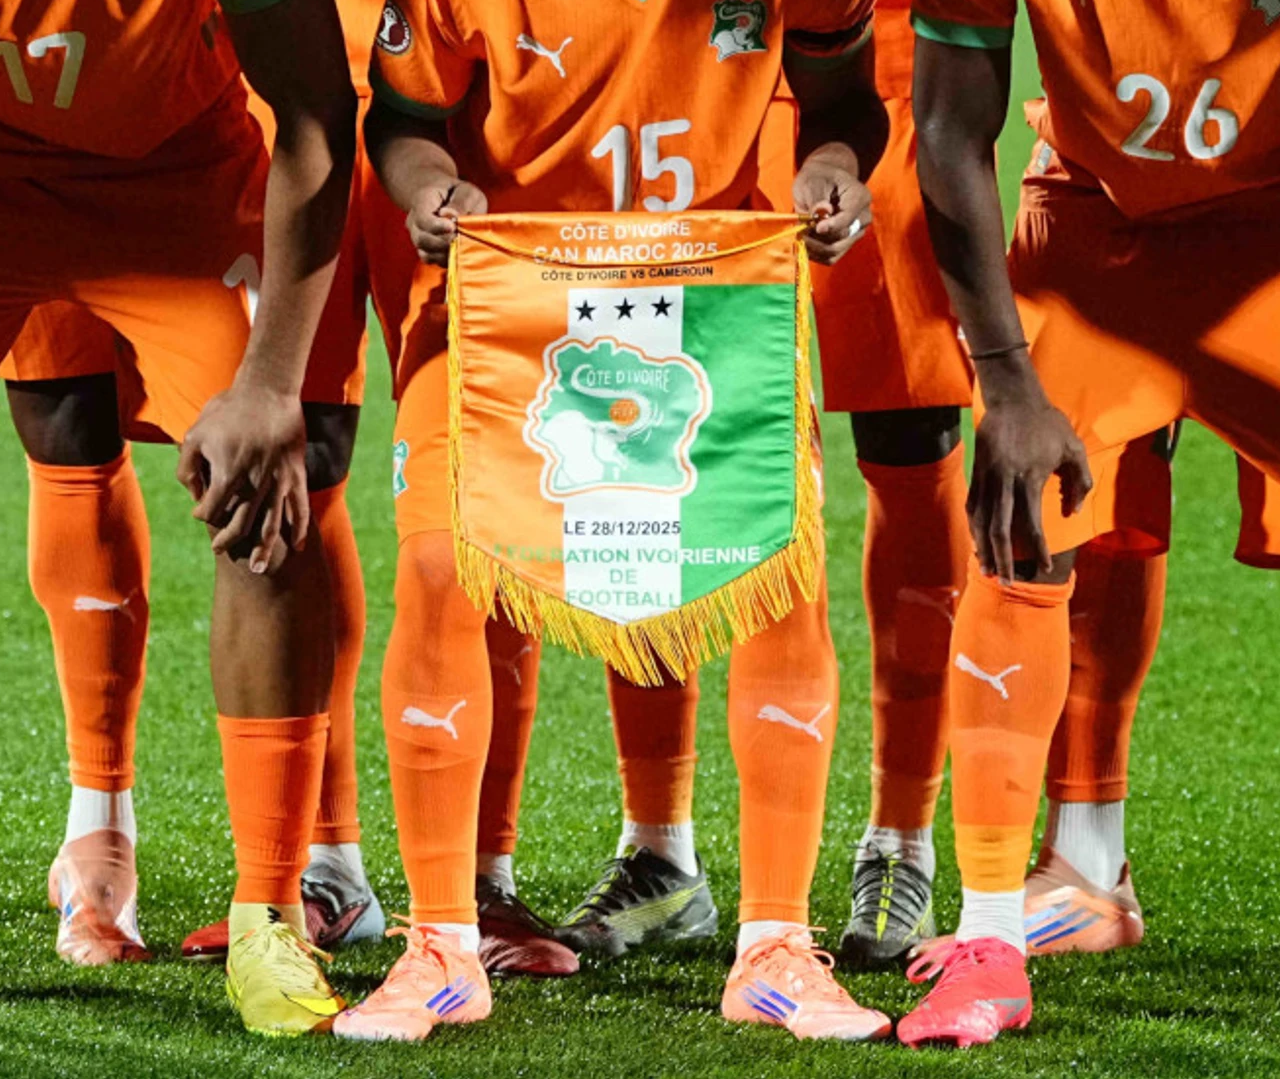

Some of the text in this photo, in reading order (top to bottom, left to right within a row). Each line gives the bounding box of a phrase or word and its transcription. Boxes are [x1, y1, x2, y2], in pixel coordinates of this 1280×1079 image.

[1116, 73, 1239, 160] 26
[591, 119, 694, 211] 15
[560, 221, 691, 241] CÔTE D'IVOIRE
[586, 243, 665, 262] MAROC
[649, 266, 714, 278] CAMEROUN
[564, 521, 681, 535] LE 28/12/2025
[637, 545, 761, 564] IVOIRIENNE
[610, 569, 637, 584] DE
[566, 589, 681, 608] FOOTBALL
